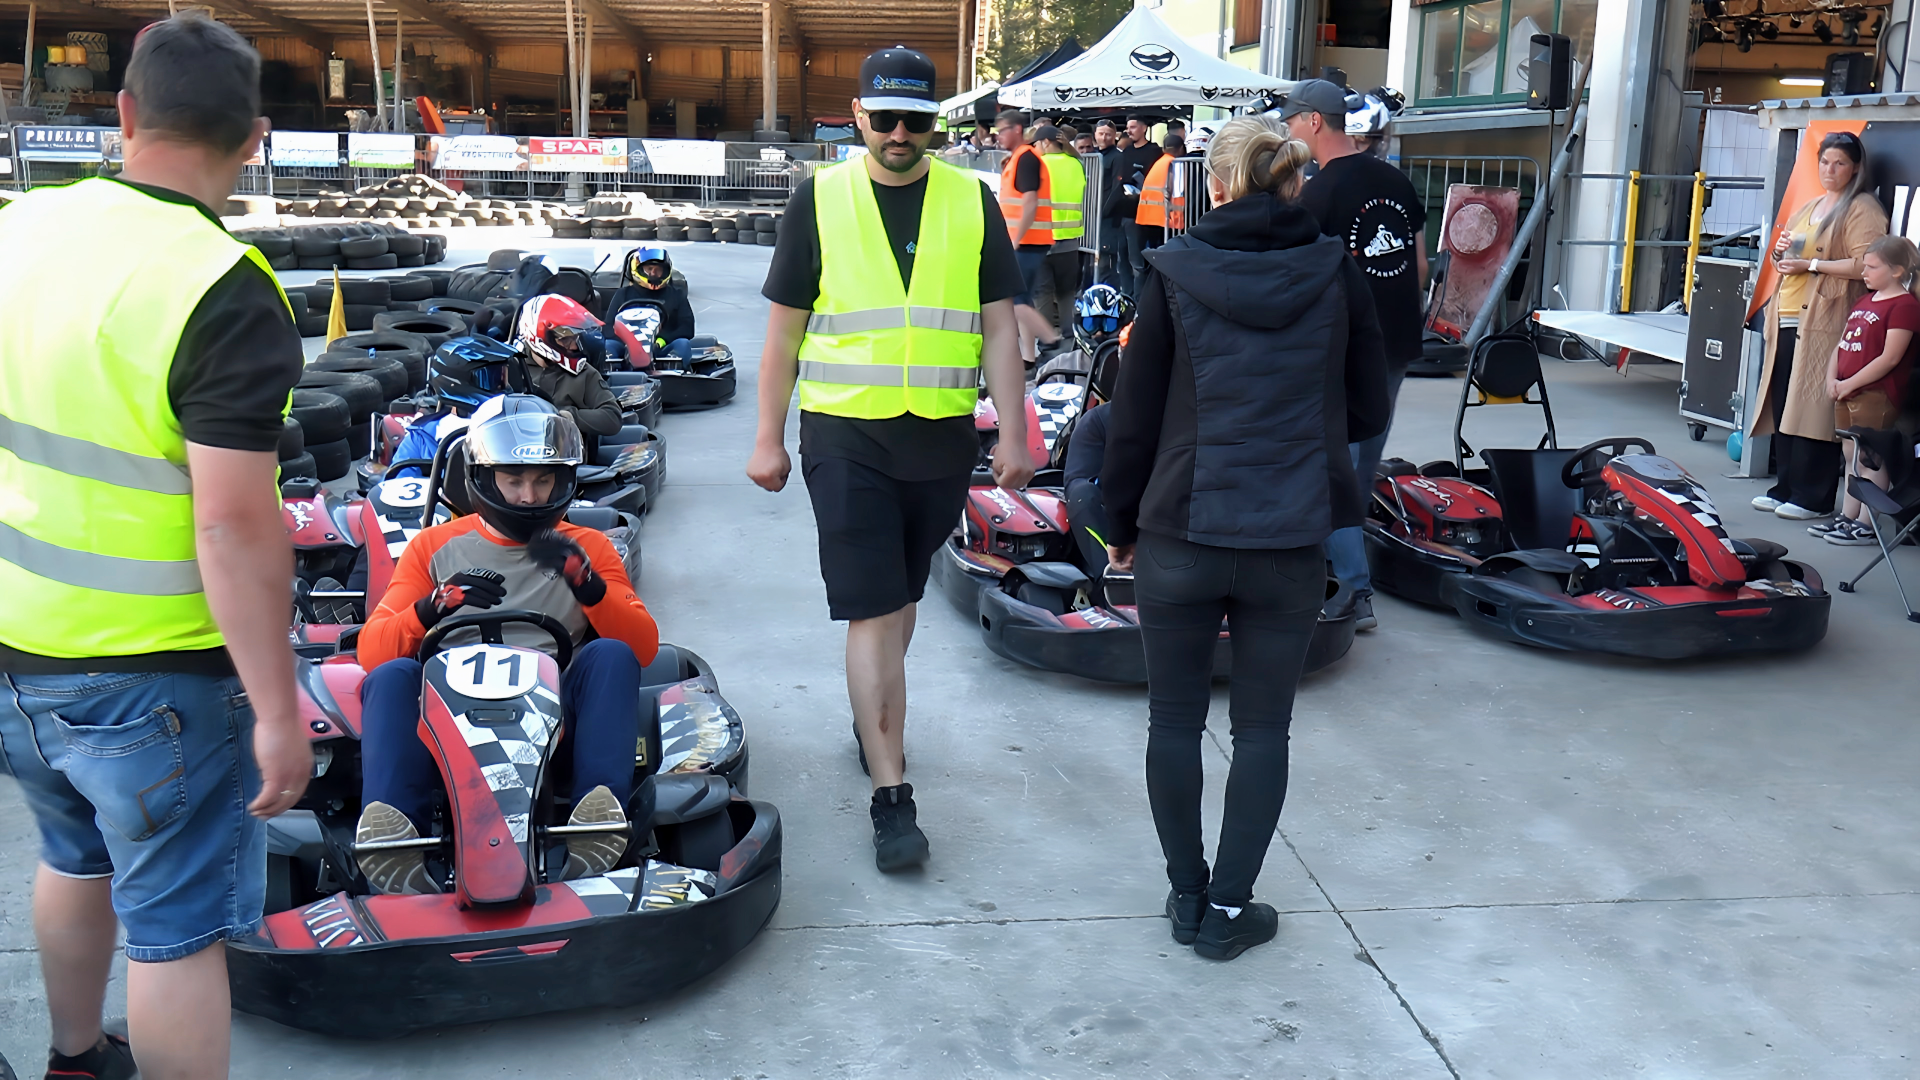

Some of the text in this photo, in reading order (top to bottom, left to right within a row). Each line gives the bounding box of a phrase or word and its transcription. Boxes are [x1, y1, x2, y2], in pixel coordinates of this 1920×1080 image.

[26, 130, 95, 143] PRIELER
[542, 141, 603, 153] SPAR
[1047, 386, 1064, 396] 4
[398, 482, 423, 501] 3
[461, 651, 521, 686] 11
